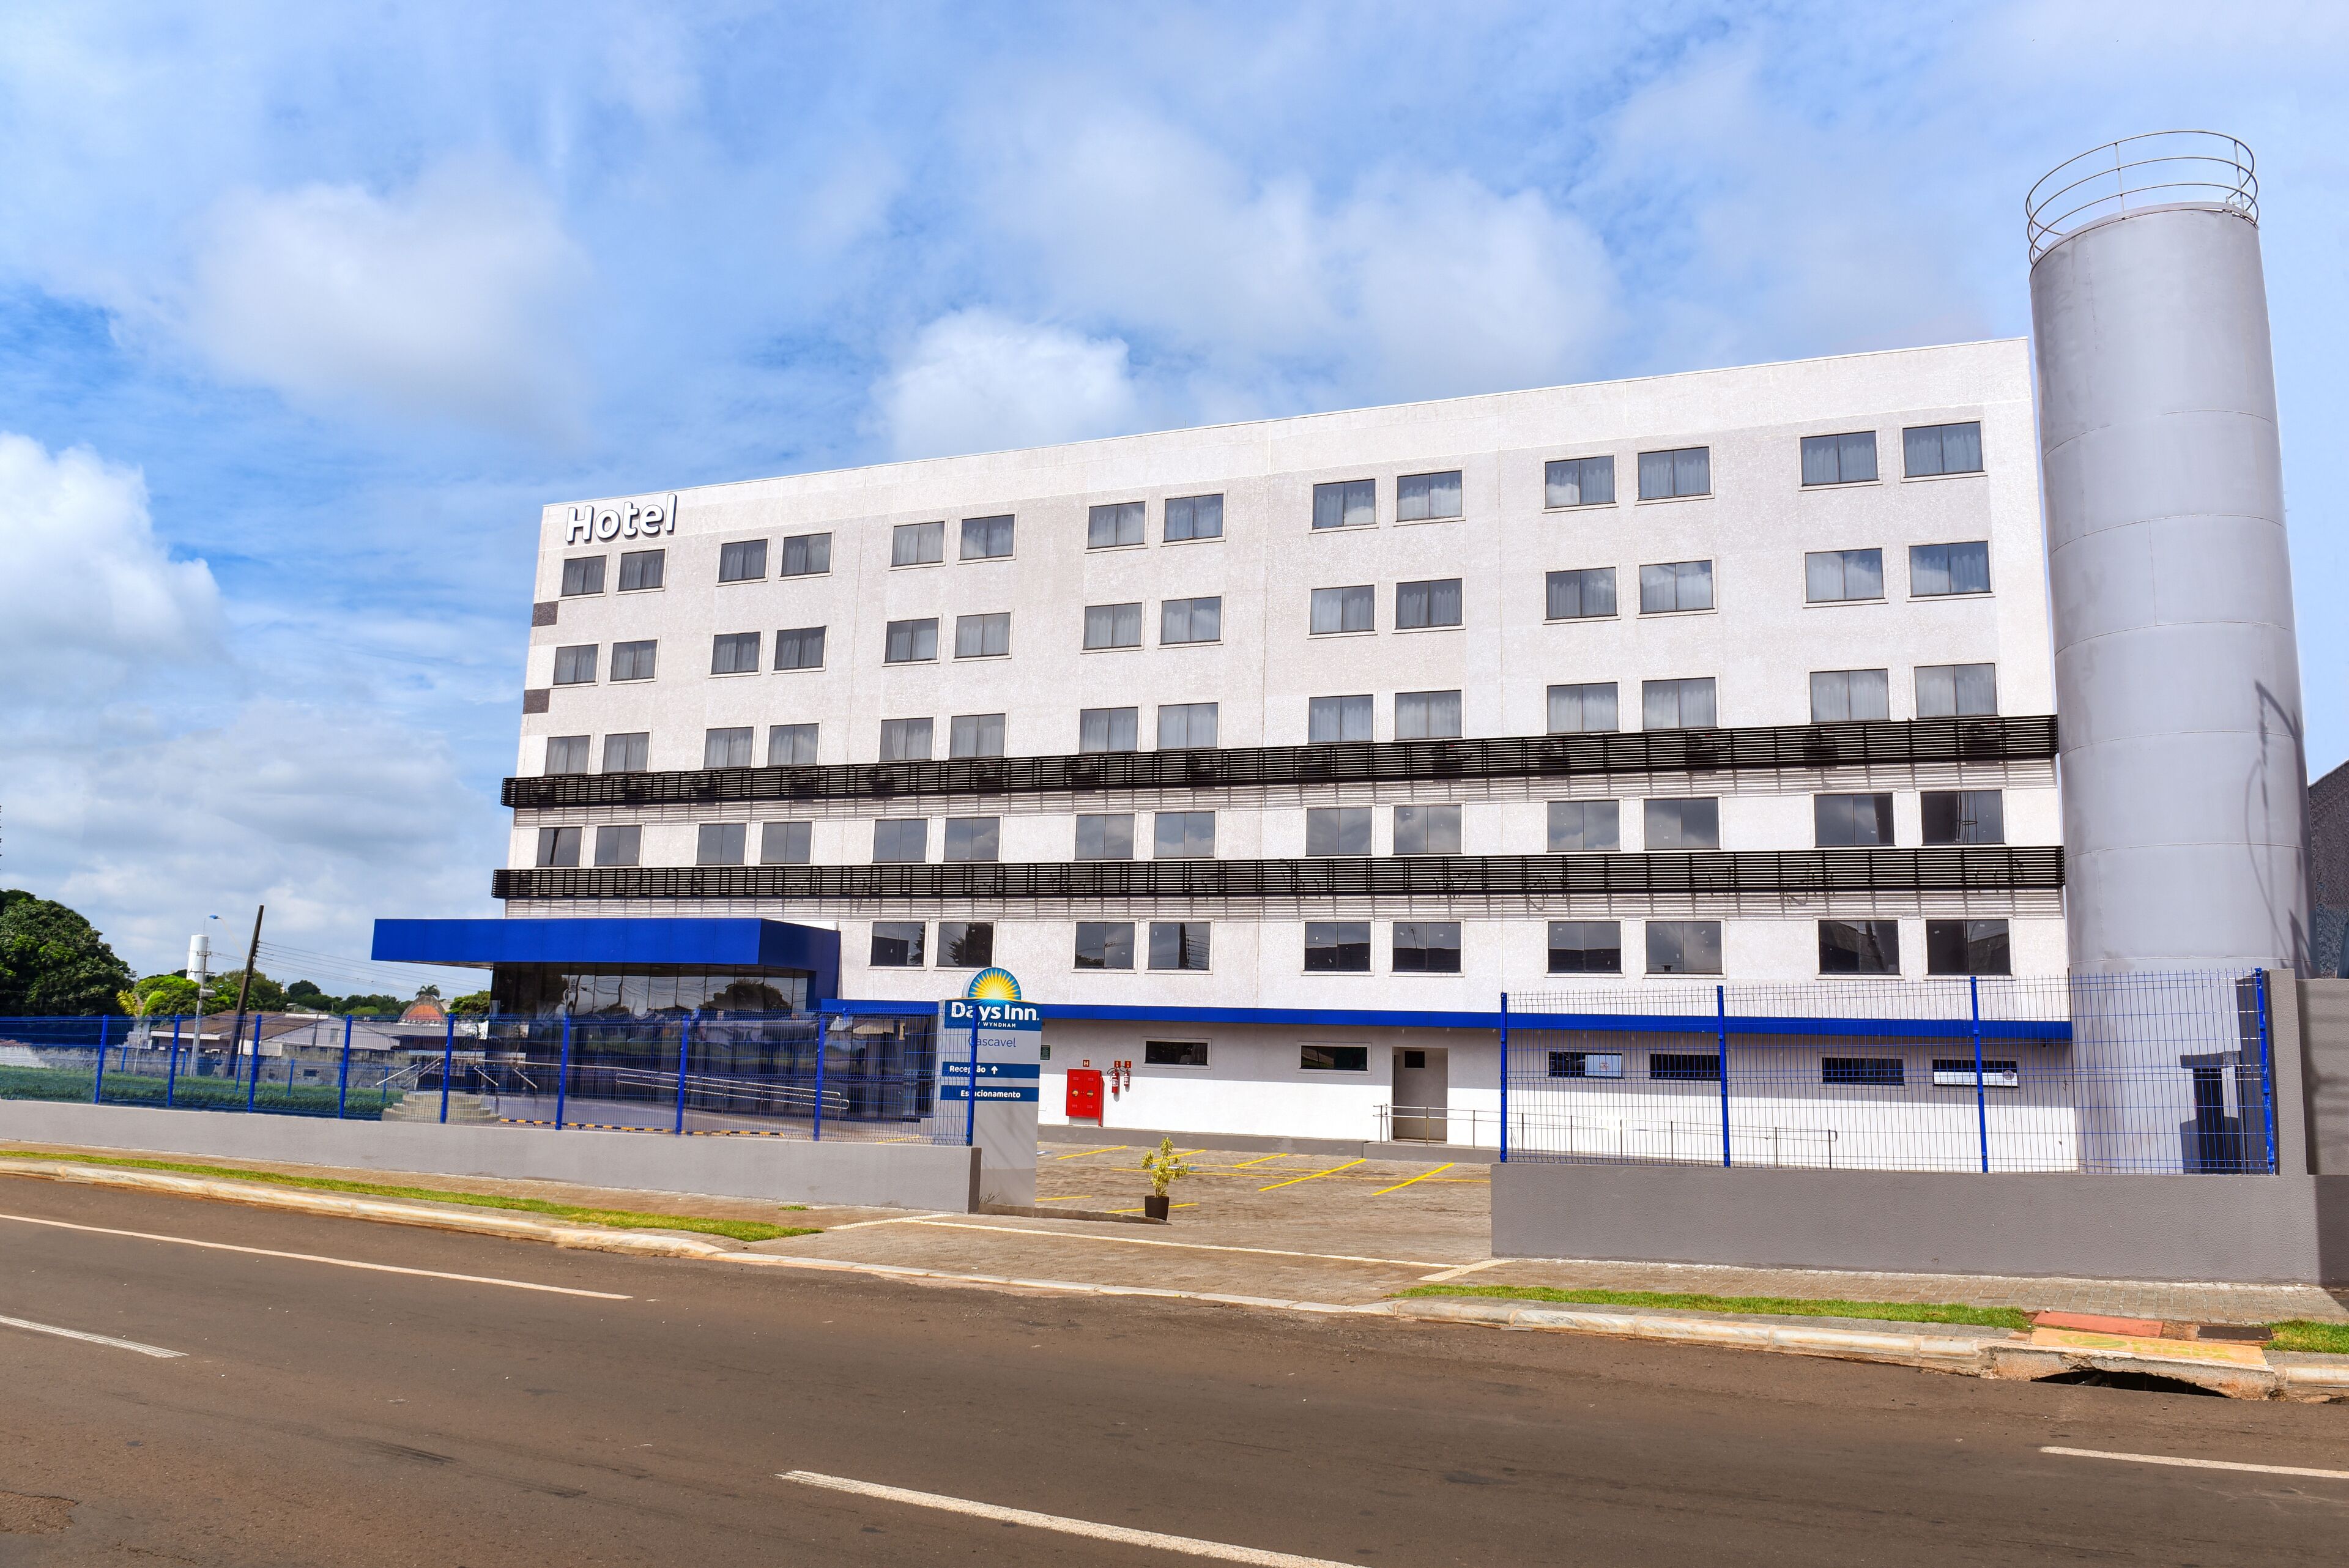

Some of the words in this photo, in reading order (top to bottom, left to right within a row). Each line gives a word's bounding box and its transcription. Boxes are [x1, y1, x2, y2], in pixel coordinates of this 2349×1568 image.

[565, 494, 677, 542] Hotel
[951, 1001, 1001, 1020] Days
[1004, 1004, 1037, 1020] Inn
[949, 1065, 986, 1074] Receão
[960, 1090, 1021, 1098] Escionamento
